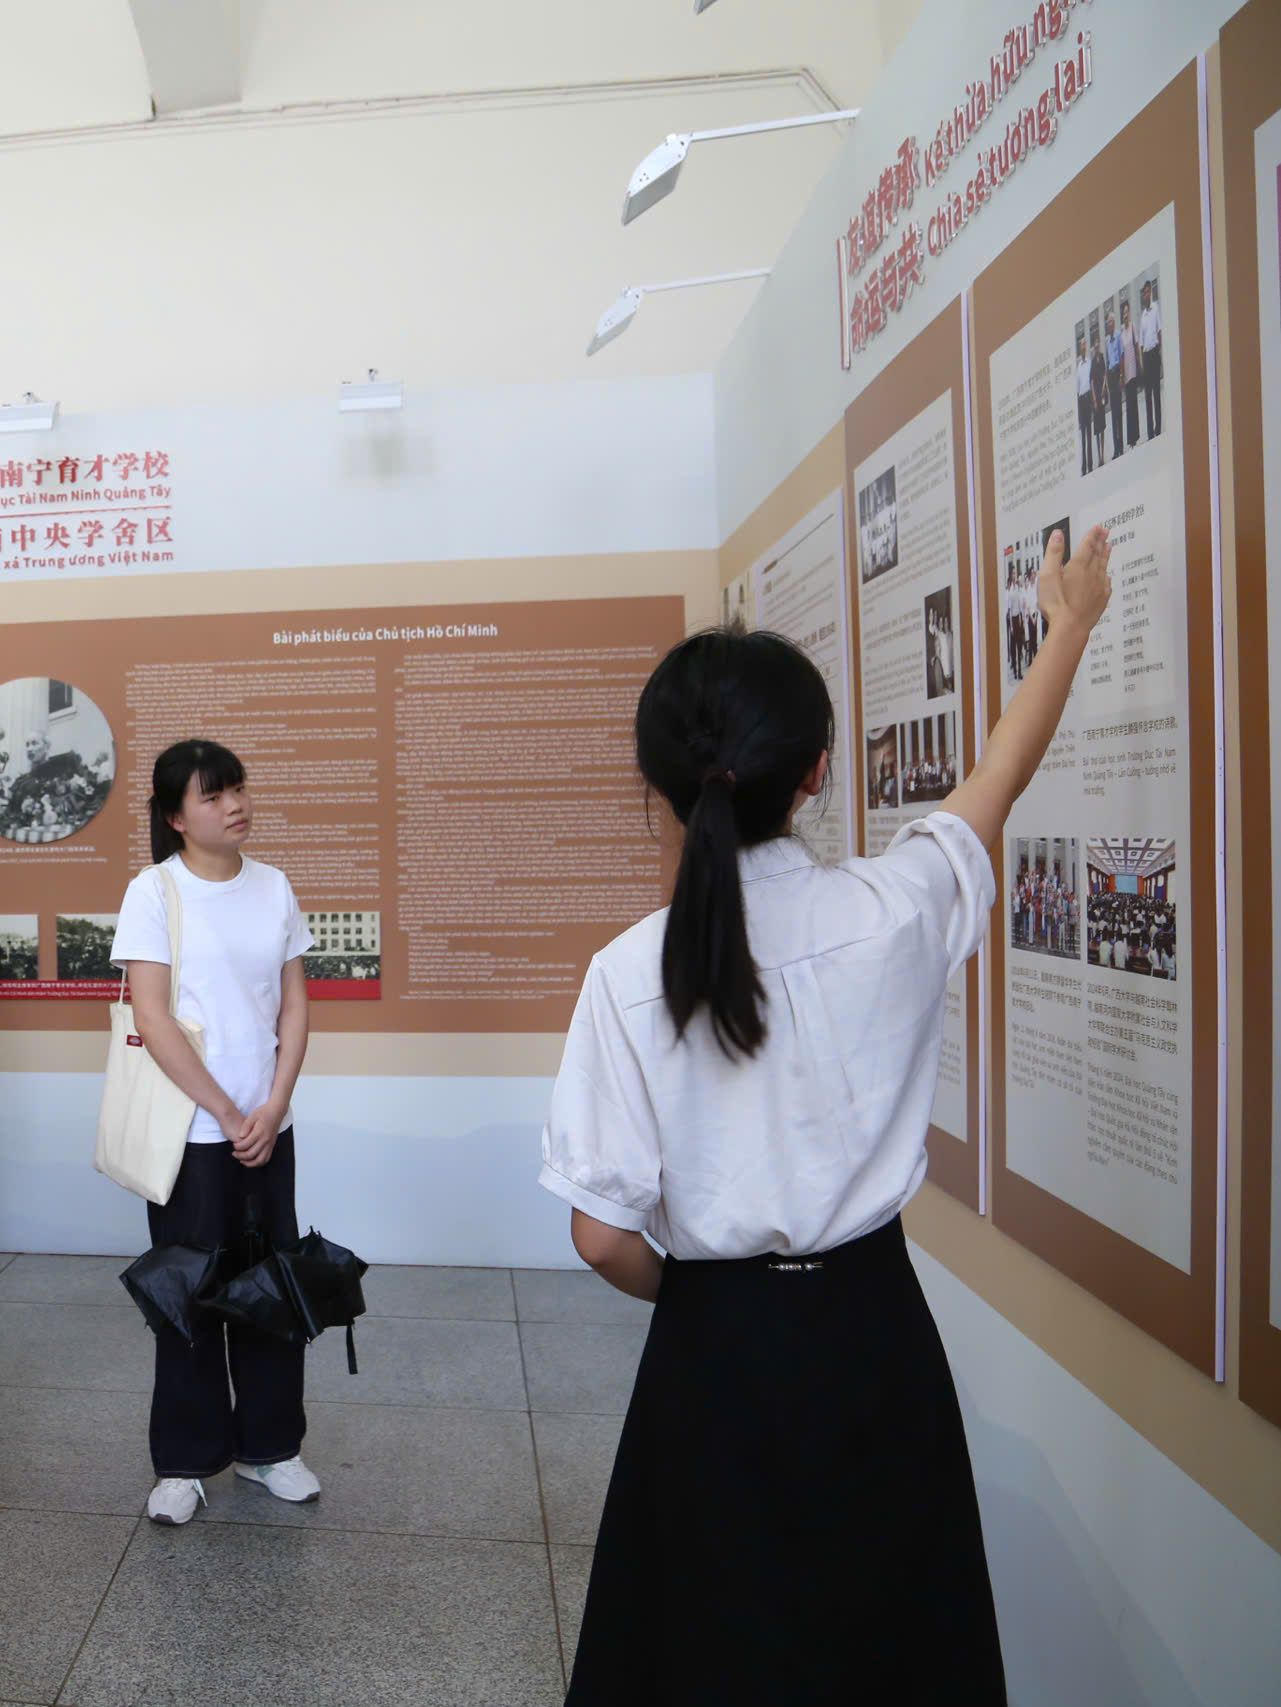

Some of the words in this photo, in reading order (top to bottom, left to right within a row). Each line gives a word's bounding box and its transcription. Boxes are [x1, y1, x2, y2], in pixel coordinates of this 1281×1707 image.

[924, 119, 945, 187] Kế
[946, 80, 988, 157] thừa
[990, 24, 1030, 102] hữu
[927, 193, 964, 257] Chia
[988, 90, 1054, 186] tương
[1054, 31, 1086, 112] lai
[847, 136, 917, 274] 友谊传承
[850, 224, 922, 352] 命运与共
[18, 491, 37, 506] Tài
[39, 491, 68, 504] Nam
[71, 488, 101, 502] Ninh
[104, 485, 147, 501] Quảng
[149, 483, 172, 499] Tây
[24, 555, 65, 569] Trung
[69, 552, 106, 568] ương
[108, 549, 138, 566] Việt
[141, 549, 174, 563] Nam
[273, 630, 293, 645] Bài
[294, 629, 322, 647] phát
[324, 628, 350, 643] biểu
[352, 629, 373, 642] của
[375, 626, 399, 641] Chủ
[401, 625, 424, 642] tịch
[427, 624, 444, 639] Hồ
[446, 622, 466, 638] Chí
[467, 623, 498, 637] Minh
